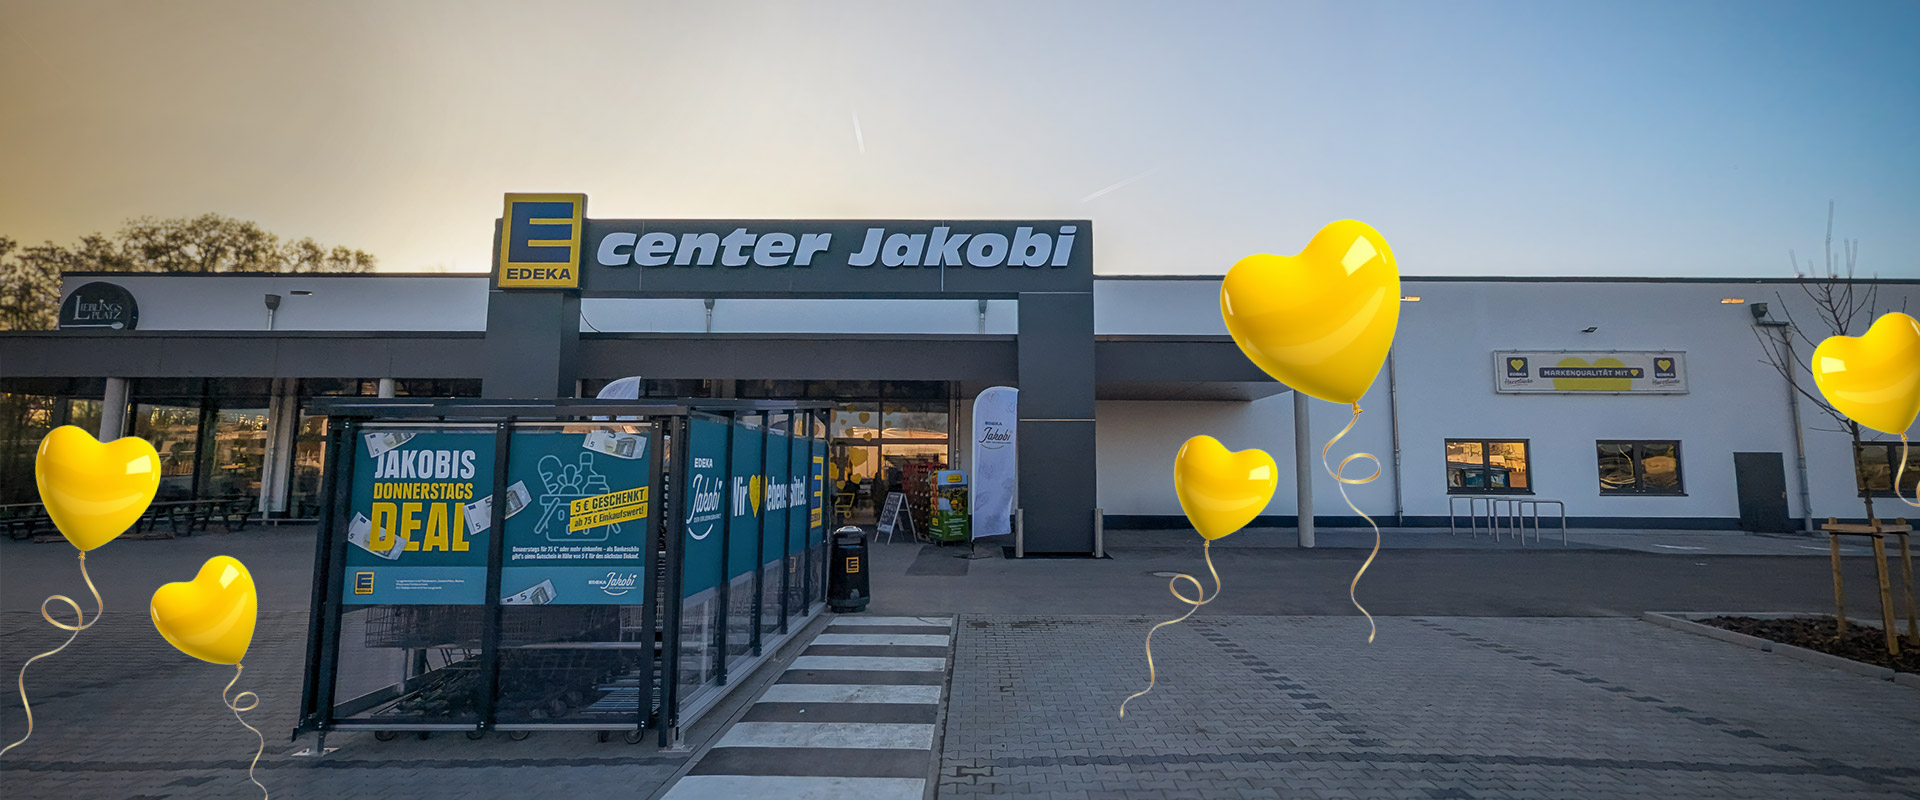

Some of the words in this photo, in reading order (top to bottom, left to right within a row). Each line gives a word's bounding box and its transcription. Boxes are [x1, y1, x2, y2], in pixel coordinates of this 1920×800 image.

[597, 227, 832, 267] center
[848, 225, 1078, 268] Jakobi
[506, 268, 571, 280] EDEKA
[91, 311, 121, 320] PLATZ
[1544, 369, 1612, 377] MARKENQUALITÄT
[1615, 369, 1628, 377] MIT
[978, 426, 1012, 443] Jakobi
[374, 449, 476, 479] JAKOBIS
[694, 458, 713, 468] EDEKA
[373, 482, 474, 500] DONNERSTAGS
[686, 473, 722, 524] Jakobi
[575, 501, 581, 513] 5
[583, 500, 590, 511] €
[592, 489, 645, 510] GESCHENKT
[574, 517, 583, 527] ab
[584, 515, 592, 525] 75
[599, 505, 645, 523] Einkaufswert!
[369, 502, 470, 552] DEAL
[600, 571, 637, 589] Jakobi
